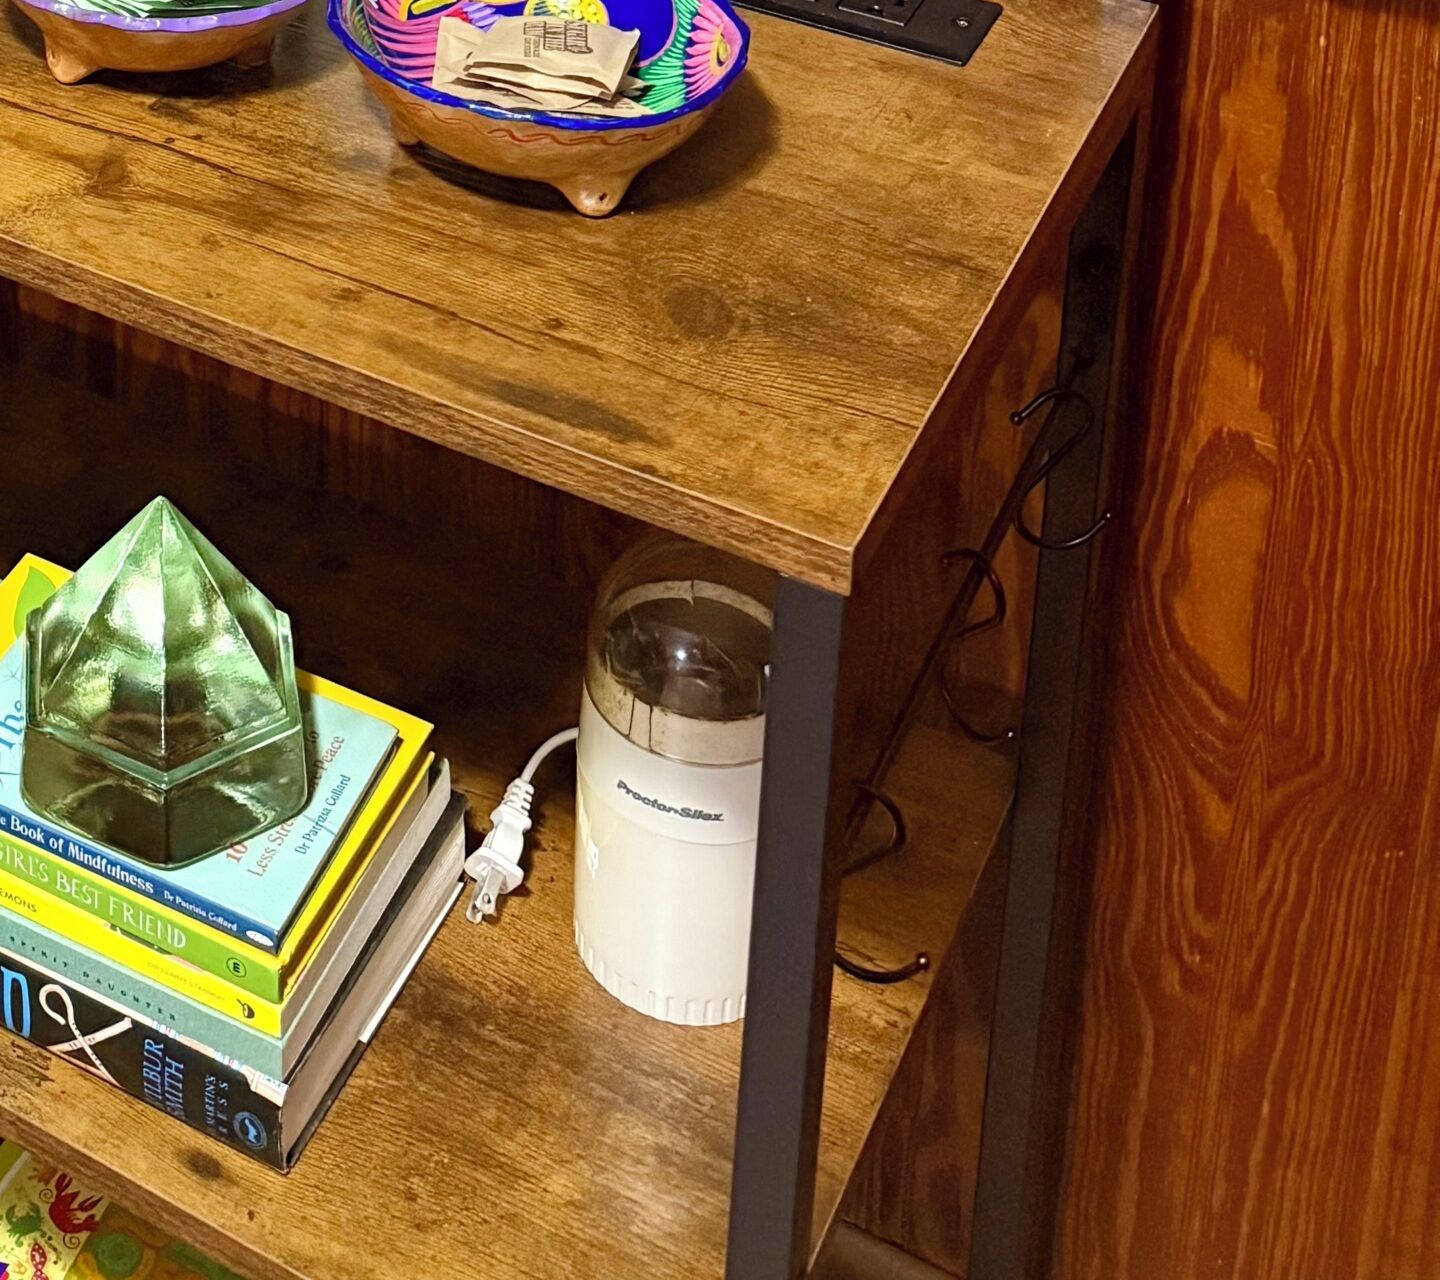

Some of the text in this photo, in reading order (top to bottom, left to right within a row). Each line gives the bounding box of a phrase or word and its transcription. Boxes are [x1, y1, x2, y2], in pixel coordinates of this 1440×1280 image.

[246, 846, 276, 877] Less
[314, 736, 345, 773] Peace
[294, 774, 351, 855] Dr Patrizia Collard
[10, 815, 46, 844] Book
[49, 837, 64, 853] of
[67, 840, 154, 894] Mindfulness
[164, 890, 174, 903] Dr
[175, 895, 207, 918] Patrizia
[208, 912, 238, 932] Collard
[56, 871, 102, 909] BEST
[109, 895, 186, 949] FRIEND
[9, 936, 70, 969] SPIRIT
[83, 971, 176, 1022] DAUGHTER
